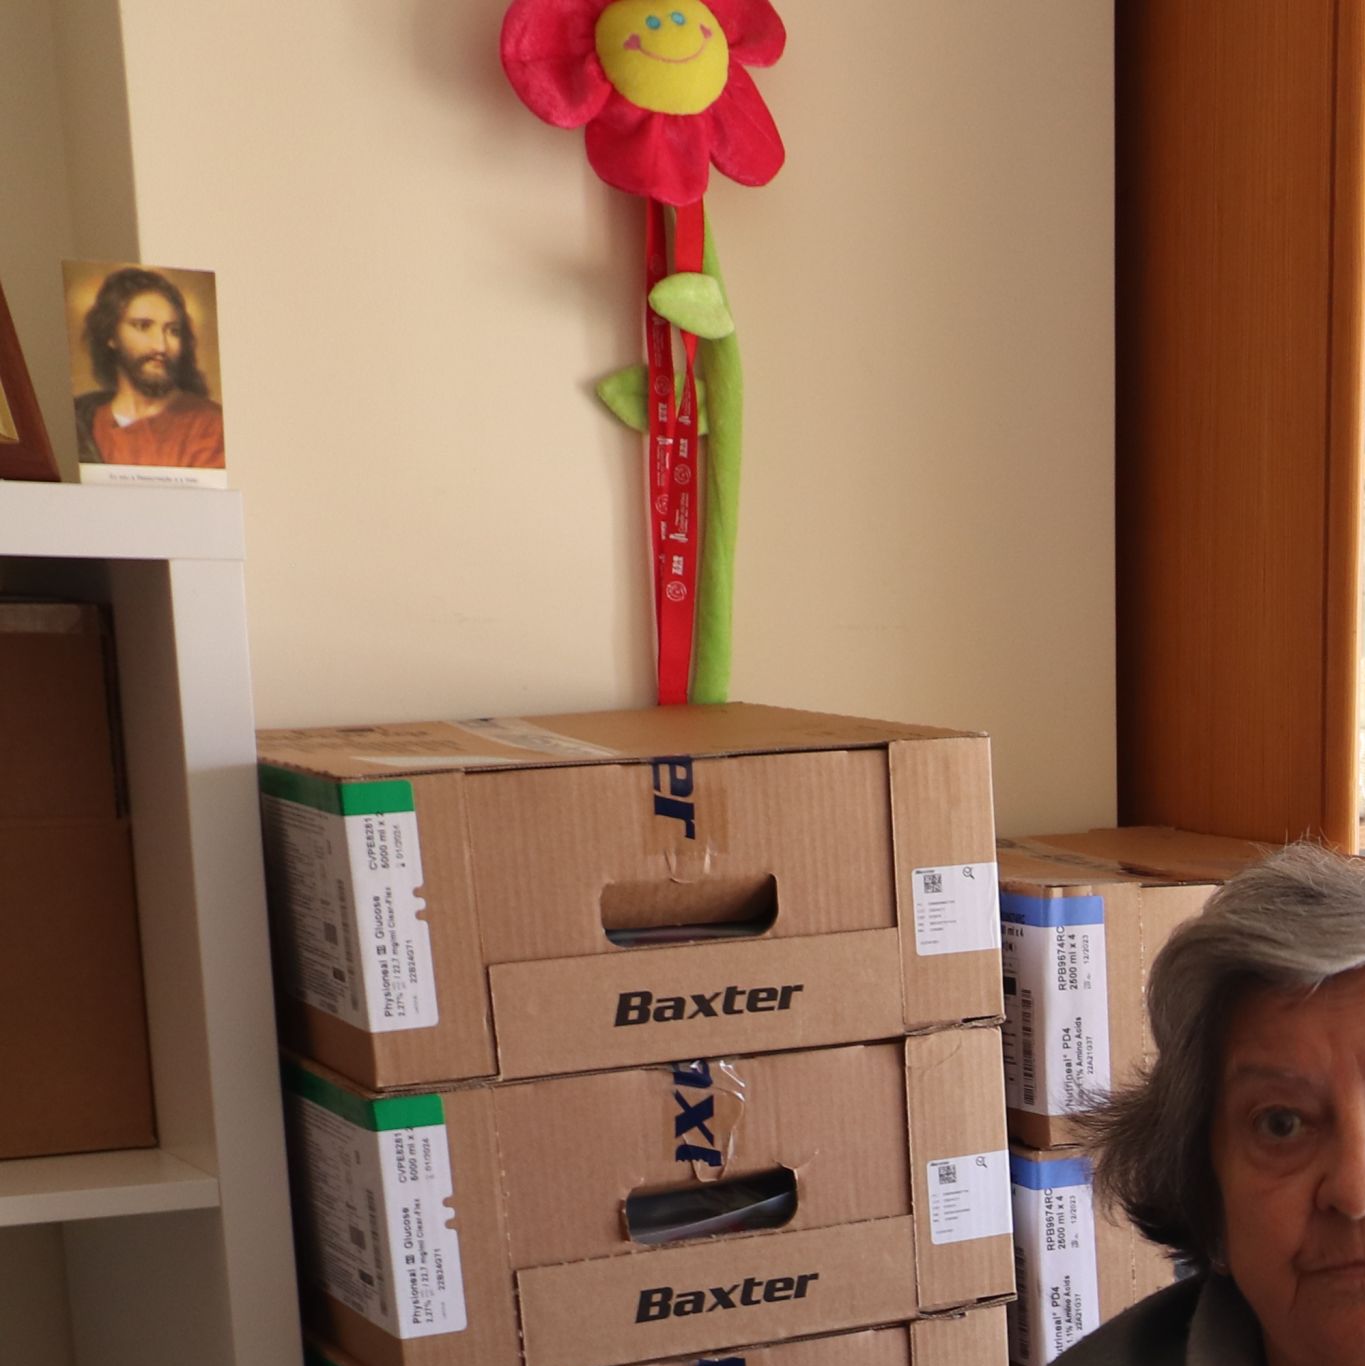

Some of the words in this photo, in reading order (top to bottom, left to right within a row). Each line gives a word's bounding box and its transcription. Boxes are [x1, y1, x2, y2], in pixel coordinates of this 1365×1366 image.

[373, 896, 384, 939] Glucose
[1056, 926, 1066, 990] RPB9674RC
[1068, 952, 1076, 964] ml
[379, 960, 393, 1017] Physioneal
[1069, 967, 1077, 990] 2500
[614, 984, 804, 1027] Baxter
[1063, 1028, 1071, 1049] PD4
[402, 1208, 413, 1249] Glucose
[1044, 1189, 1055, 1251] RPB9674RC
[1056, 1212, 1065, 1224] ml
[1057, 1227, 1066, 1249] 2500
[407, 1269, 421, 1324] Physioneal
[634, 1273, 819, 1324] Baxter
[1051, 1286, 1060, 1307] PD4
[1063, 1276, 1071, 1297] Acids
[1052, 1316, 1063, 1355] utrineal
